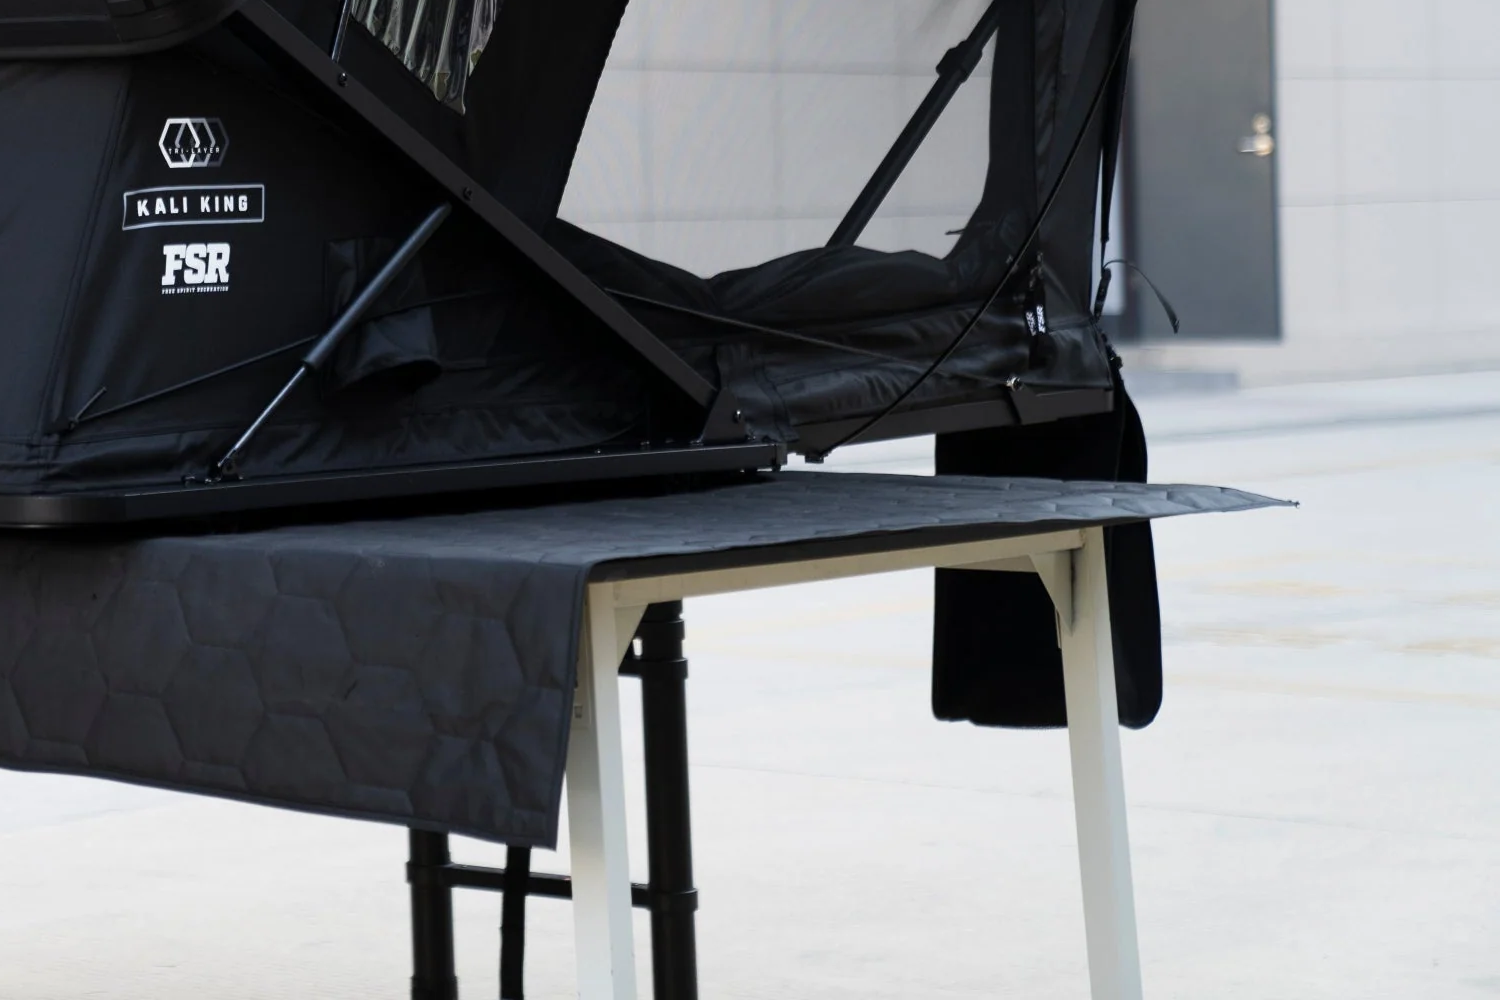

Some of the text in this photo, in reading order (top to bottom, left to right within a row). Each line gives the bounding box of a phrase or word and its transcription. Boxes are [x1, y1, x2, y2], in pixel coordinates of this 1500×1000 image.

[168, 146, 220, 155] TRI-LAYER
[137, 195, 248, 217] KALI KING
[161, 243, 231, 286] FSR
